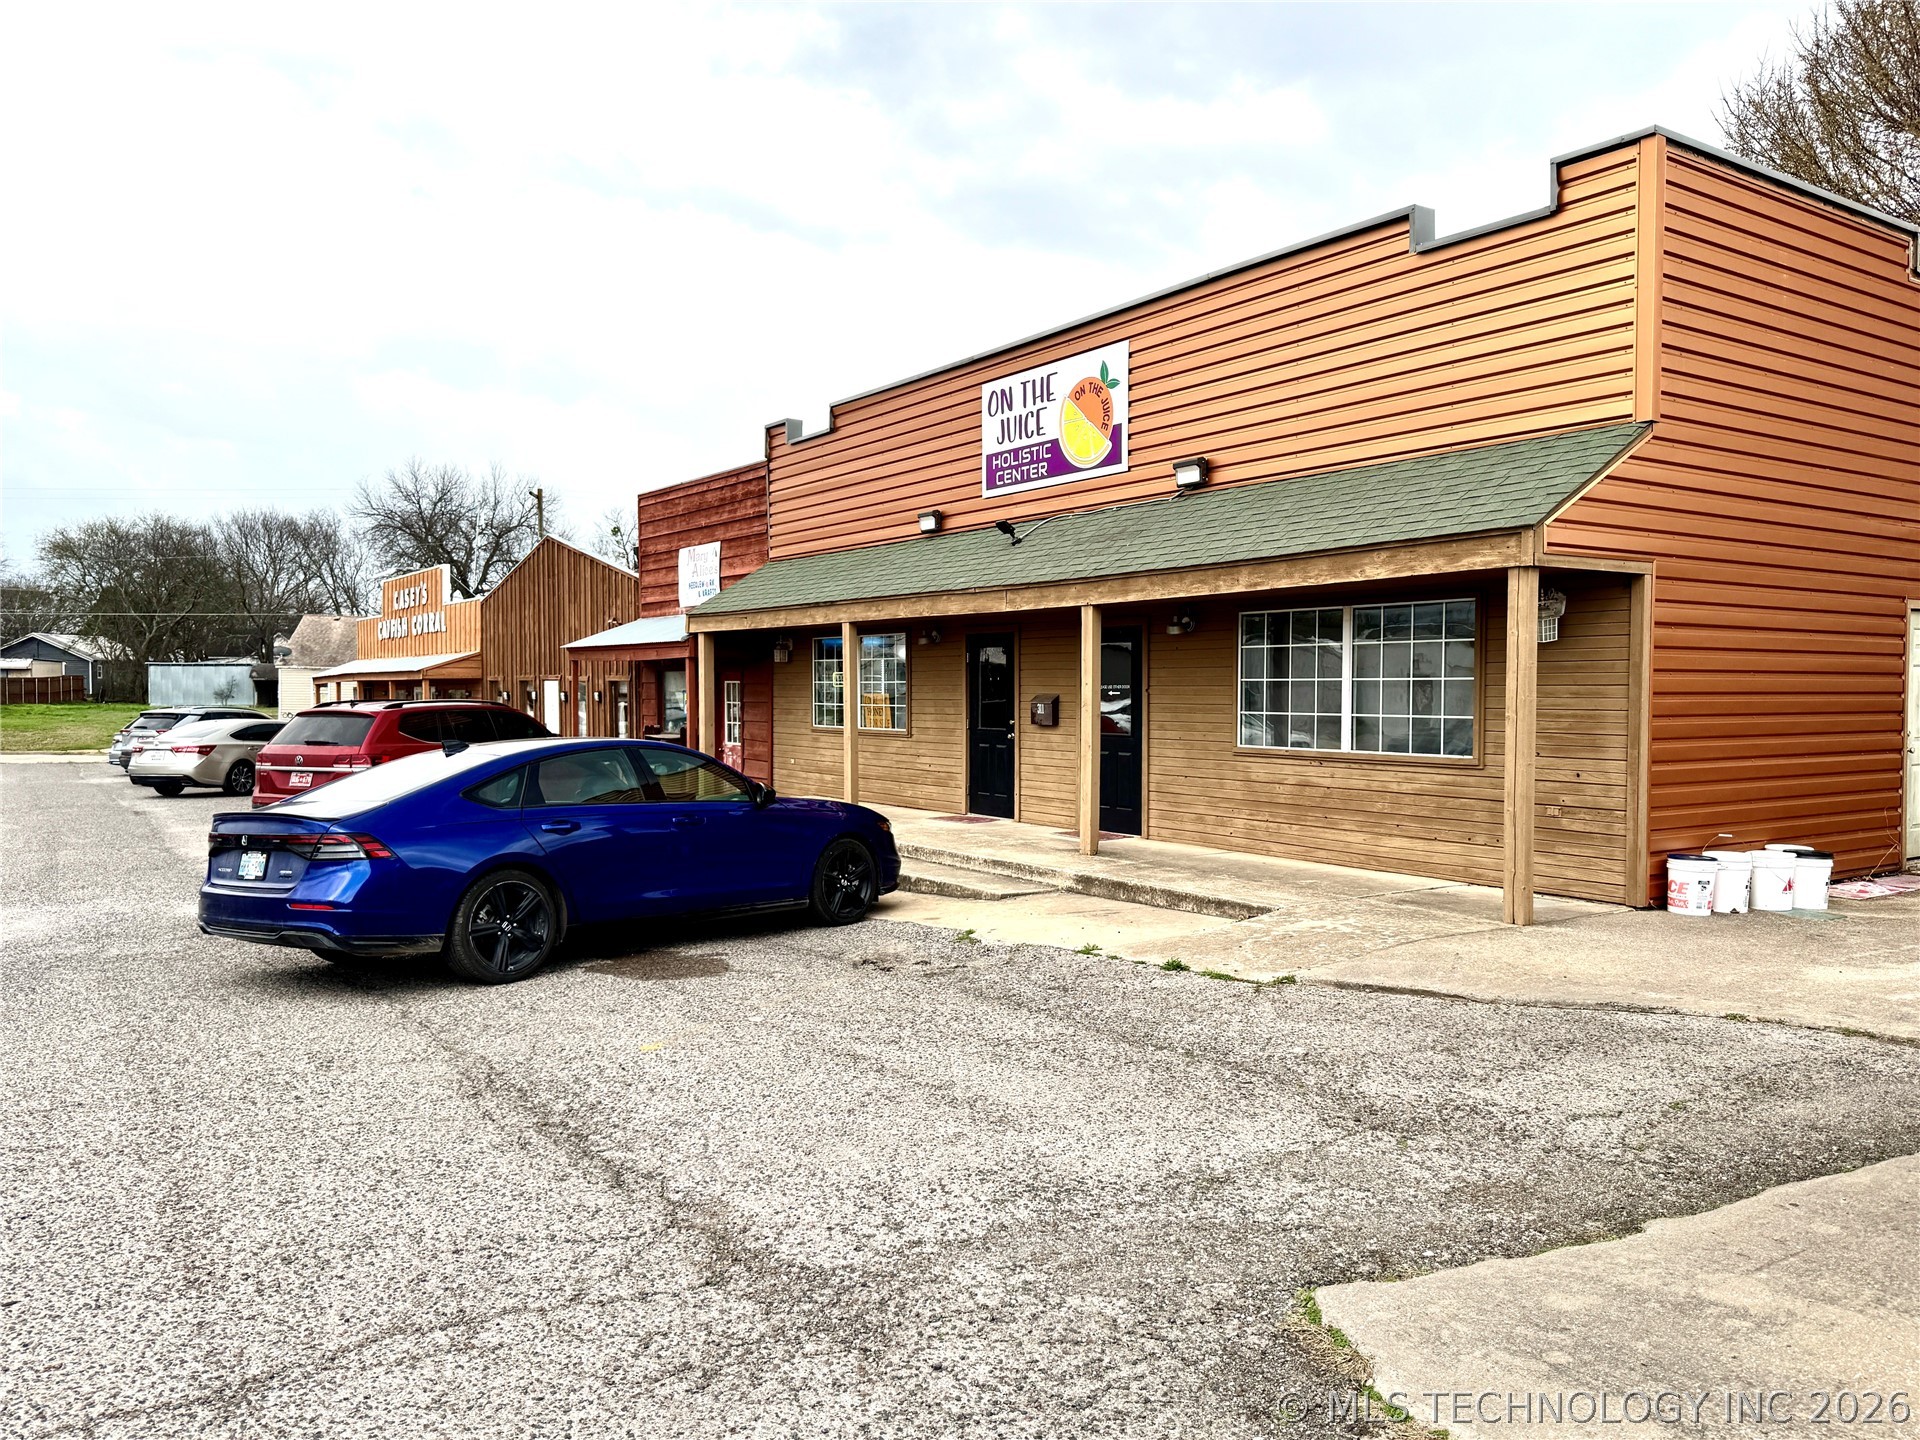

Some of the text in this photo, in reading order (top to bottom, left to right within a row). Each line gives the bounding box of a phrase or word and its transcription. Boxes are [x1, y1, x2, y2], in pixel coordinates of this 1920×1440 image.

[987, 371, 1058, 417] ON THE
[1074, 381, 1111, 431] ON THE JUICE
[996, 406, 1048, 445] JUICE
[992, 443, 1052, 470] HOLISTIC
[995, 461, 1048, 485] CENTER
[393, 581, 428, 610] CASEY'S
[411, 610, 447, 636] CORRAL
